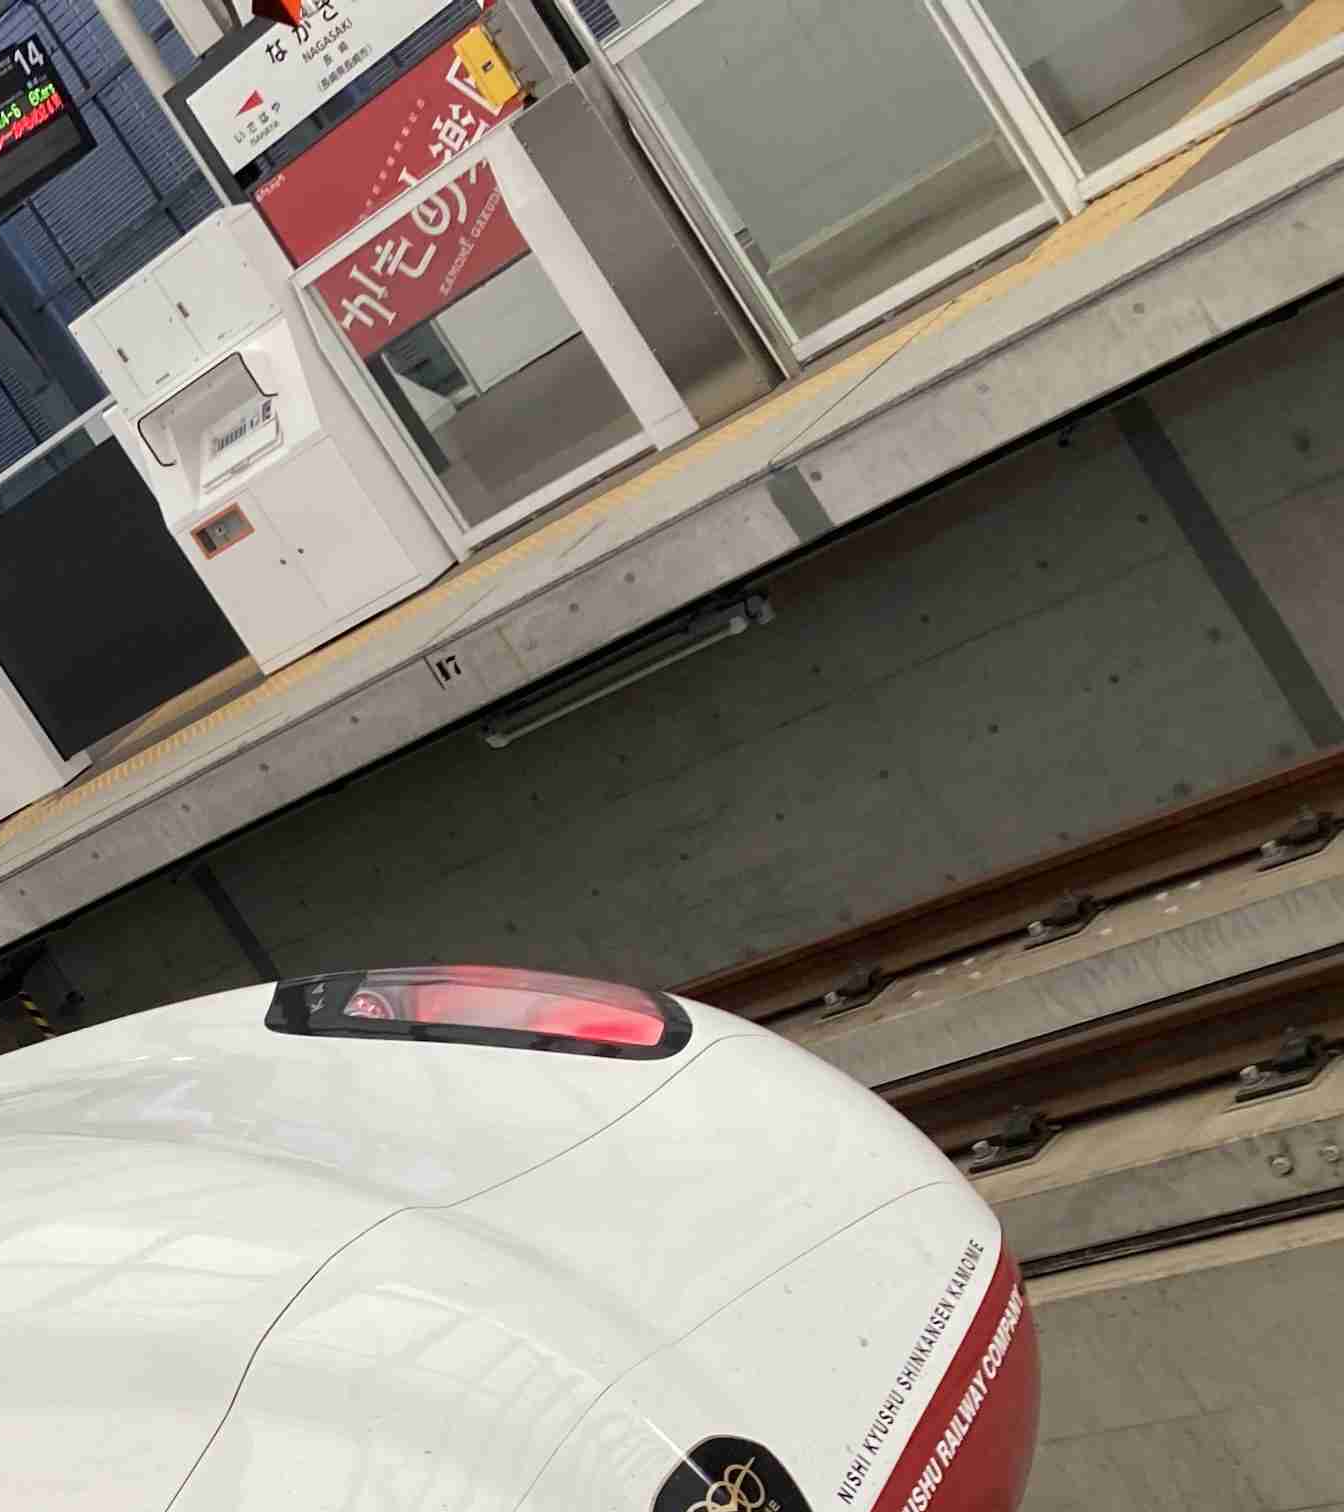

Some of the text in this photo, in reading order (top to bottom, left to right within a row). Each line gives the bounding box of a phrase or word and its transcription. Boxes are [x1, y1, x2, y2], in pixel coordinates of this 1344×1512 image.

[14, 40, 44, 75] 14
[302, 17, 353, 63] NAGASAKI
[837, 1238, 985, 1504] NISHI KYUSHU SHINKANSEN KAMOME
[936, 1370, 989, 1467] RAILWAY
